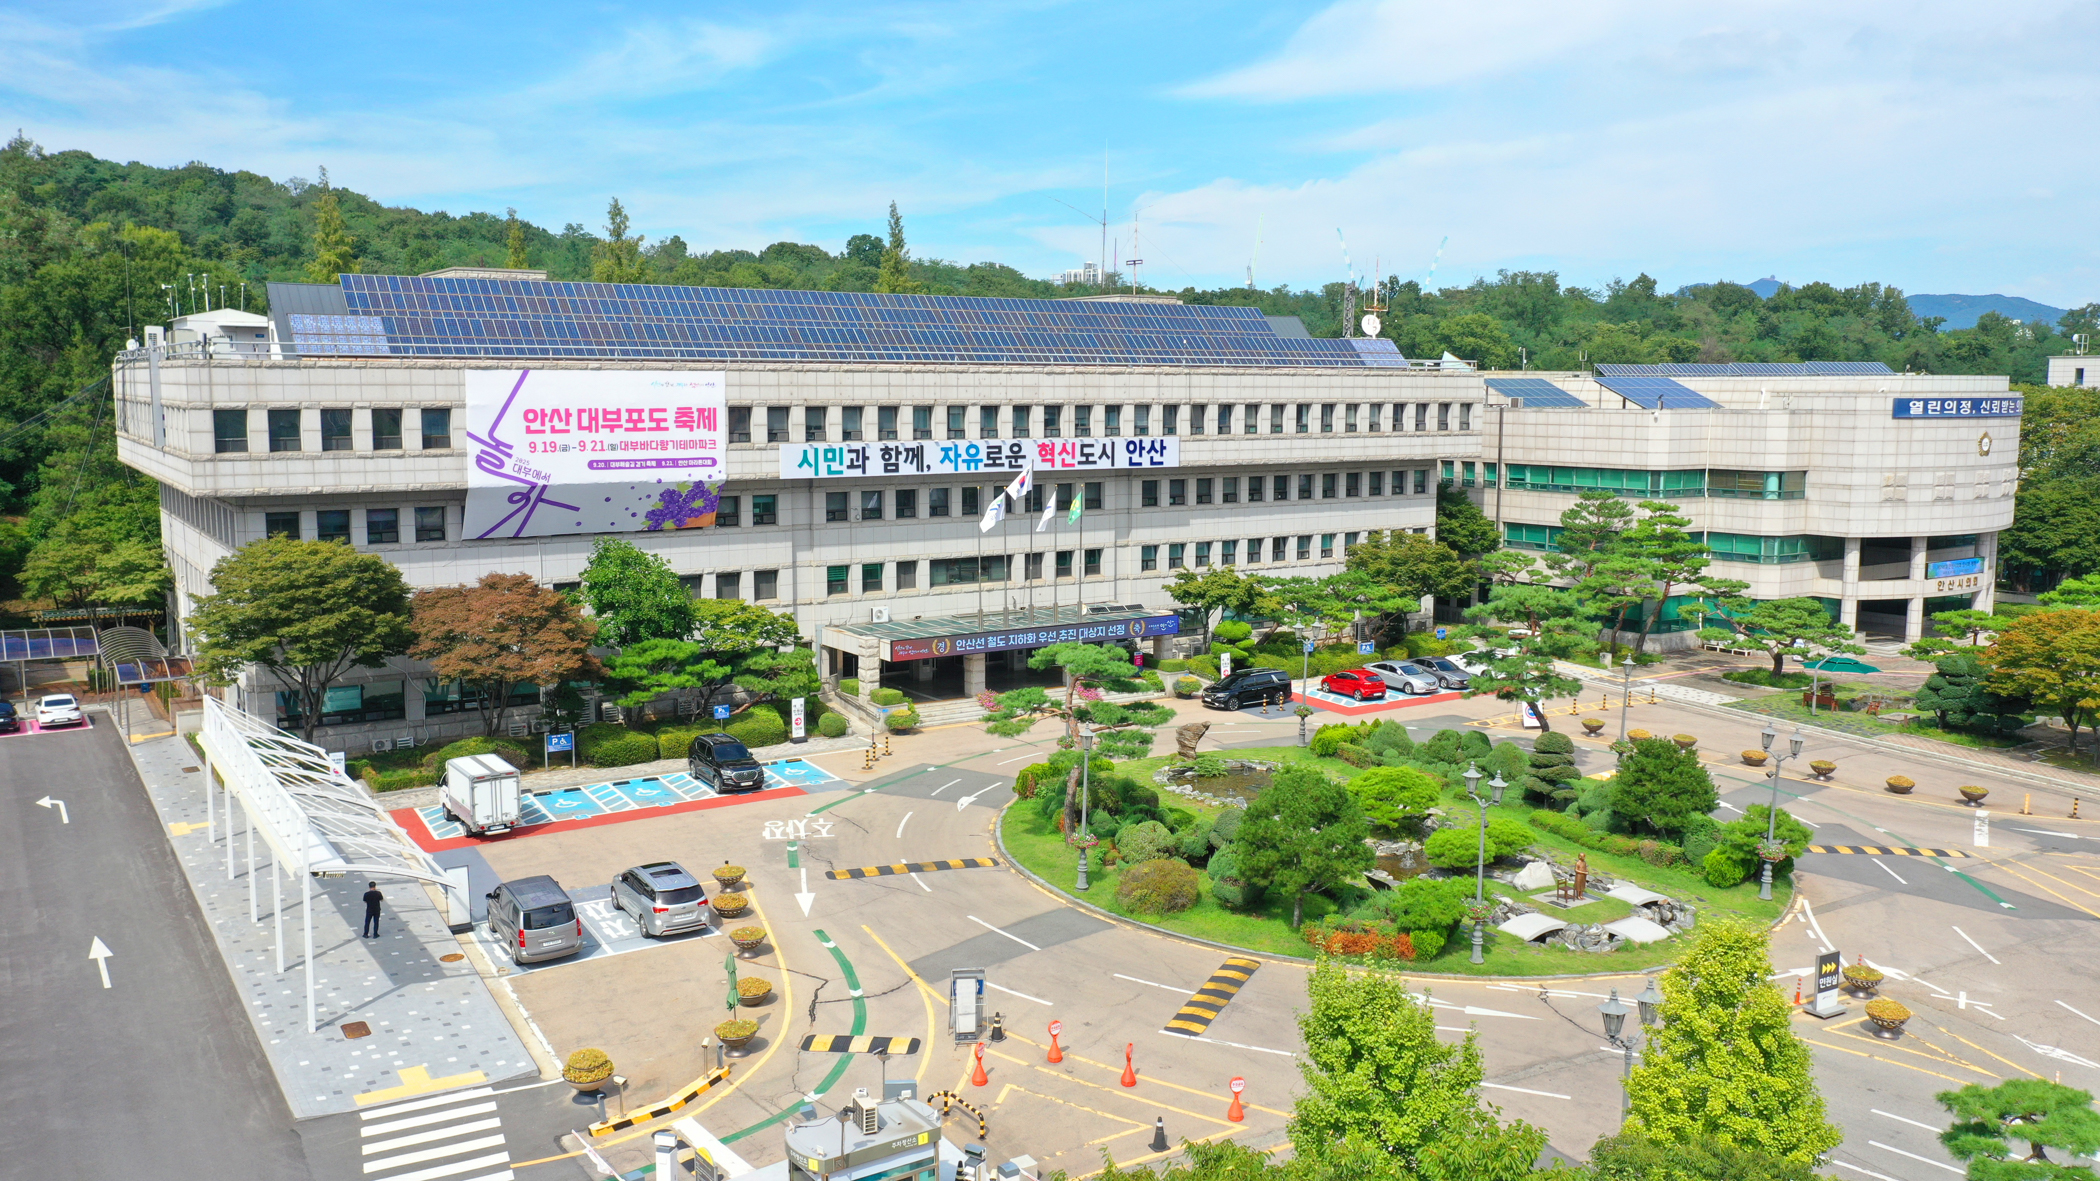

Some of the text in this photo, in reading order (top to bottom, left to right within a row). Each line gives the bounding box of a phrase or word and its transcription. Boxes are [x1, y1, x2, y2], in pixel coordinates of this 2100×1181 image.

[1909, 400, 1976, 415] 열린의정,
[1980, 400, 2015, 414] 신뢰받는
[523, 406, 717, 434] 안산 대부포도 축제
[619, 439, 717, 451] 대부바다향기테마파크
[797, 439, 1167, 476] 시민과 함께, 자유로운 혁신도시 안산
[512, 463, 551, 485] 대부에서
[1937, 576, 1978, 591] 안산시의회
[956, 624, 1125, 651] 안산선 철도 지하화 우선 추진 대상지 선정
[761, 818, 836, 840] 주차장
[1819, 974, 1838, 989] 민원실
